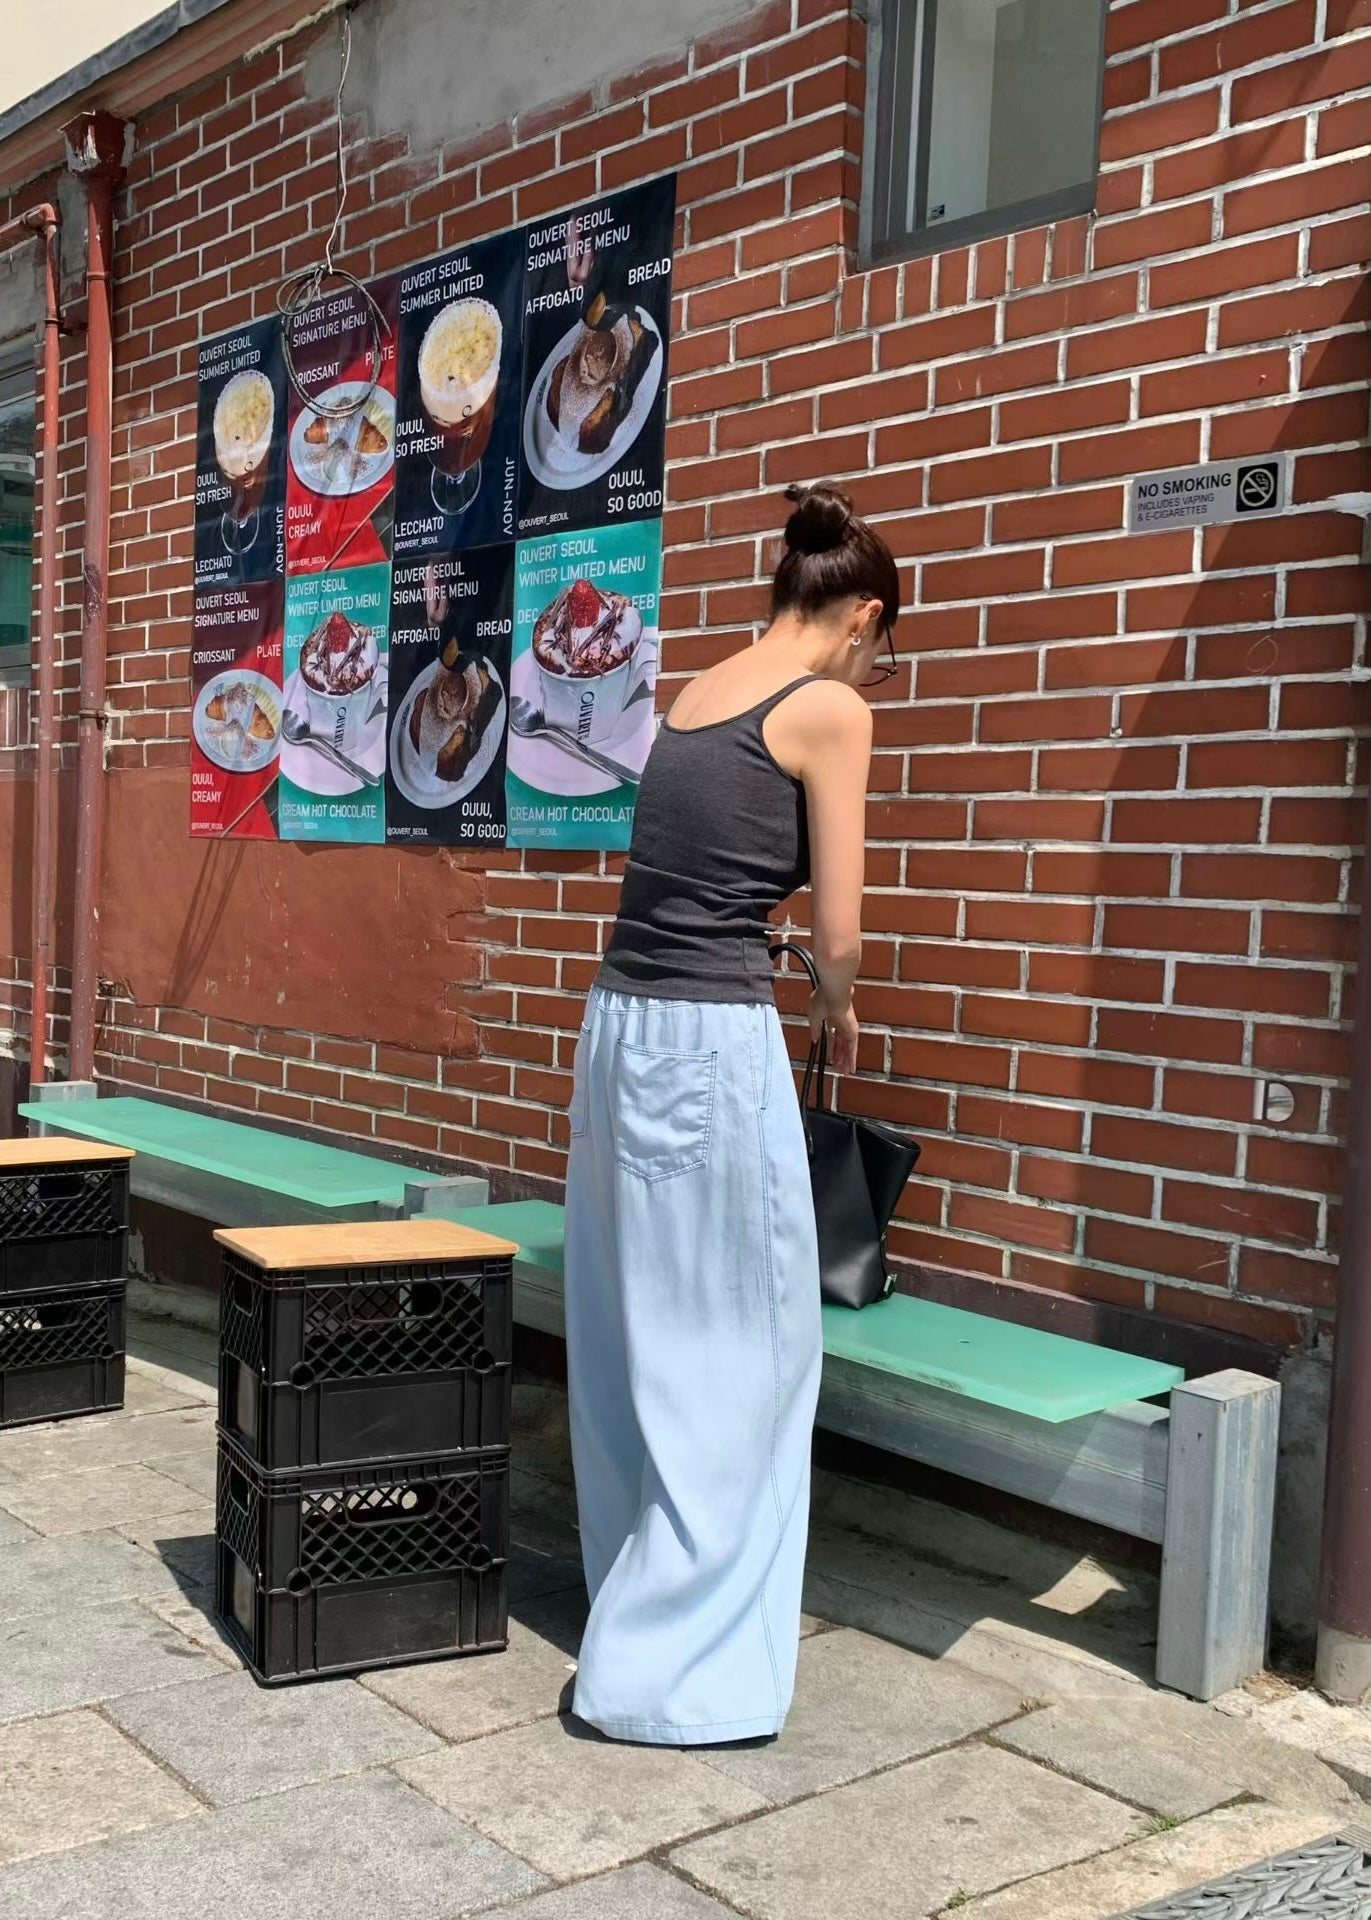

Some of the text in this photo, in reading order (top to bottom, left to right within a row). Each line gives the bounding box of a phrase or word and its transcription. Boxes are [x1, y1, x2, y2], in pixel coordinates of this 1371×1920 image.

[528, 207, 615, 249] OUVERT SEOUL
[526, 224, 631, 272] SIGNATURE MENU
[401, 256, 472, 294] OUVERT SEOUL
[627, 257, 672, 286] BREAD
[400, 273, 484, 315] SUMMER LIMITED
[524, 285, 585, 316] AFFOGATO
[293, 295, 356, 329] OUVERT SEOUL
[292, 311, 367, 348] SIGNATURE MENU
[199, 334, 253, 364] OUVERT SEOUL
[198, 349, 261, 382] SUMMER LIMITED
[296, 361, 341, 386] RIOSSANT
[396, 418, 425, 437] OUUU,
[395, 434, 445, 458] SO FRESH
[196, 472, 219, 489] OUUU,
[608, 468, 646, 490] OUUU,
[1138, 472, 1232, 499] NO SMOKING
[195, 486, 232, 506] SO FRESH
[502, 456, 516, 536] JUN-NOV
[606, 489, 663, 514] SO GOOD
[1137, 492, 1215, 512] INCLUDES VAPING
[288, 504, 313, 520] OUUU,
[518, 511, 570, 530] @OUVERT_SEOUL
[1145, 504, 1208, 521] E-CIGARETTES
[288, 520, 322, 540] CREAMY
[394, 515, 445, 538] LECCHATO
[275, 506, 285, 573] JUN-NOV
[519, 538, 598, 566] OUVERT SEOUL
[195, 555, 232, 574] LECCHATO
[394, 561, 465, 585] OUVERT SEOUL
[519, 555, 647, 589] WINTER LIMITED MENU
[195, 591, 249, 610] OUVERT SEOUL
[288, 581, 348, 599] OUVERT SEOUL
[392, 580, 479, 605] SIGNATURE MENU
[287, 592, 381, 618] WINTER LIMITED MENU
[517, 593, 656, 625] DEC FEB
[194, 608, 260, 628] SIGNATURE MENU
[476, 619, 512, 637] BREAD
[371, 624, 386, 639] FEB
[391, 627, 441, 645] AFFOGATO
[193, 648, 236, 665] CRIOSSANT
[256, 643, 282, 659] PLATE
[192, 773, 214, 787] OUUU,
[191, 790, 221, 803] CREAMY
[282, 804, 377, 818] CREAM HOT CHOCOLATE
[461, 802, 493, 820] OUUU,
[509, 806, 546, 821] CREAM
[547, 806, 569, 822] HOT
[460, 823, 507, 839] SO GOOD
